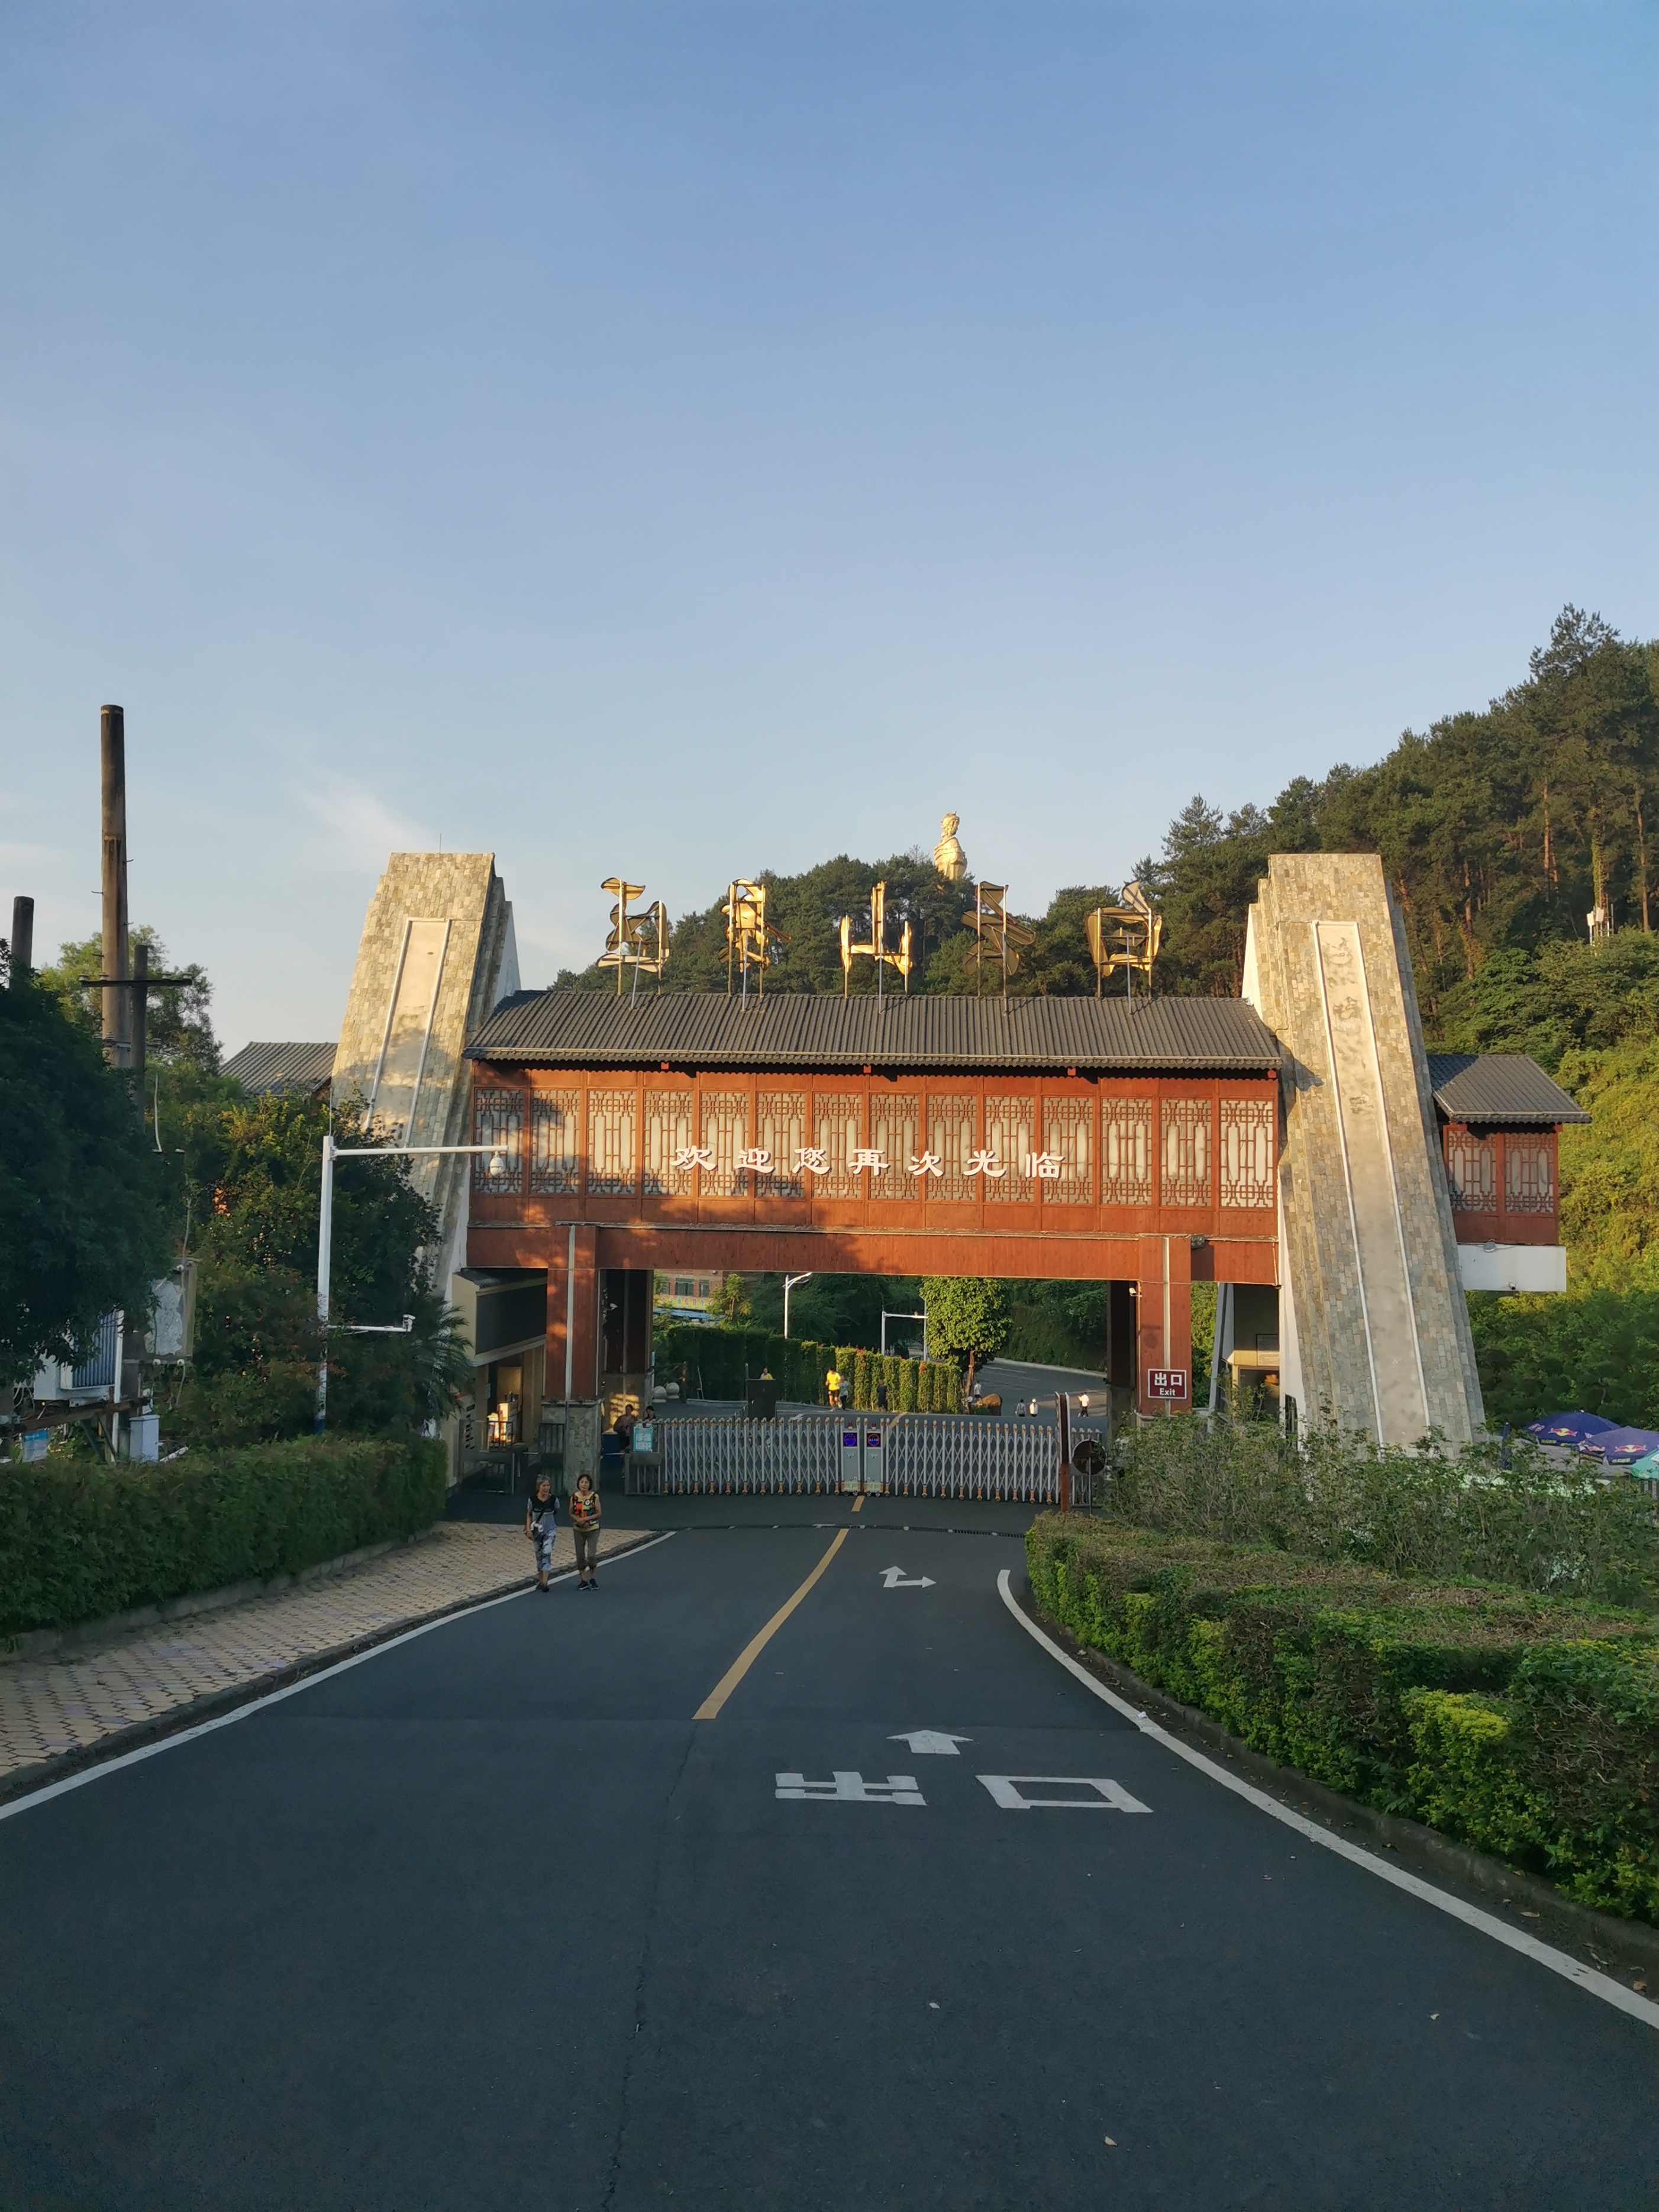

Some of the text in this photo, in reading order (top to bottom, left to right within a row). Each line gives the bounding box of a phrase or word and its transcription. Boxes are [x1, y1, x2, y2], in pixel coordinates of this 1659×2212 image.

[670, 1144, 1065, 1179] 欢迎您再次光临
[1154, 1372, 1182, 1386] 出口
[1159, 1388, 1176, 1397] Exit
[775, 1771, 1154, 1814] 出口
